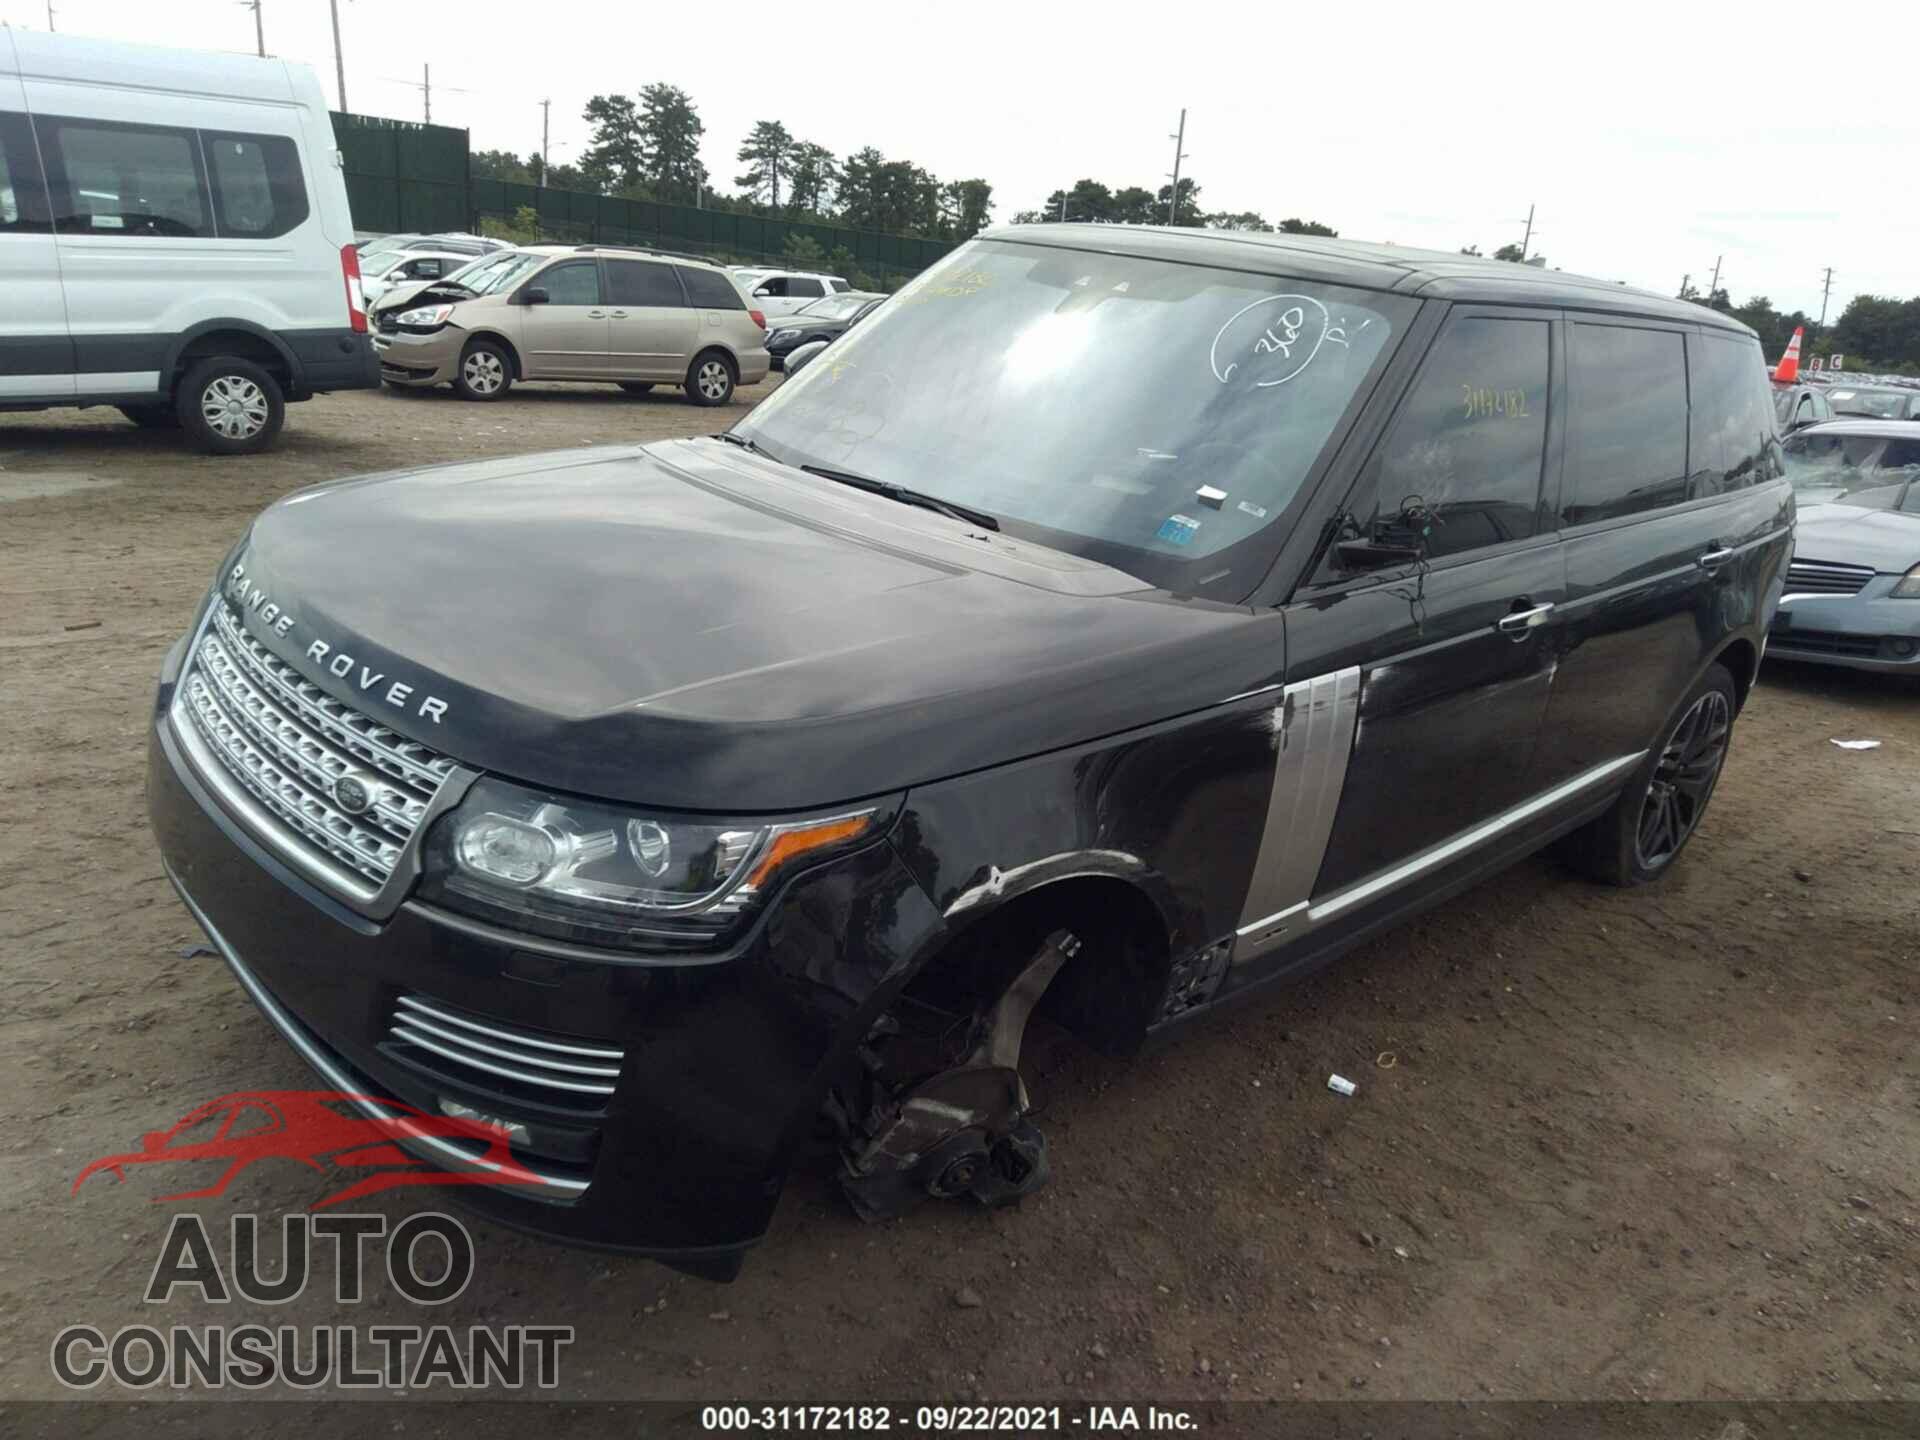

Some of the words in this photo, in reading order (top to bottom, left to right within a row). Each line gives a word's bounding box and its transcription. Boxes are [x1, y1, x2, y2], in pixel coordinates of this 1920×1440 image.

[1255, 306, 1304, 359] 360
[231, 564, 295, 639] RANGE
[306, 639, 448, 724] ROVER
